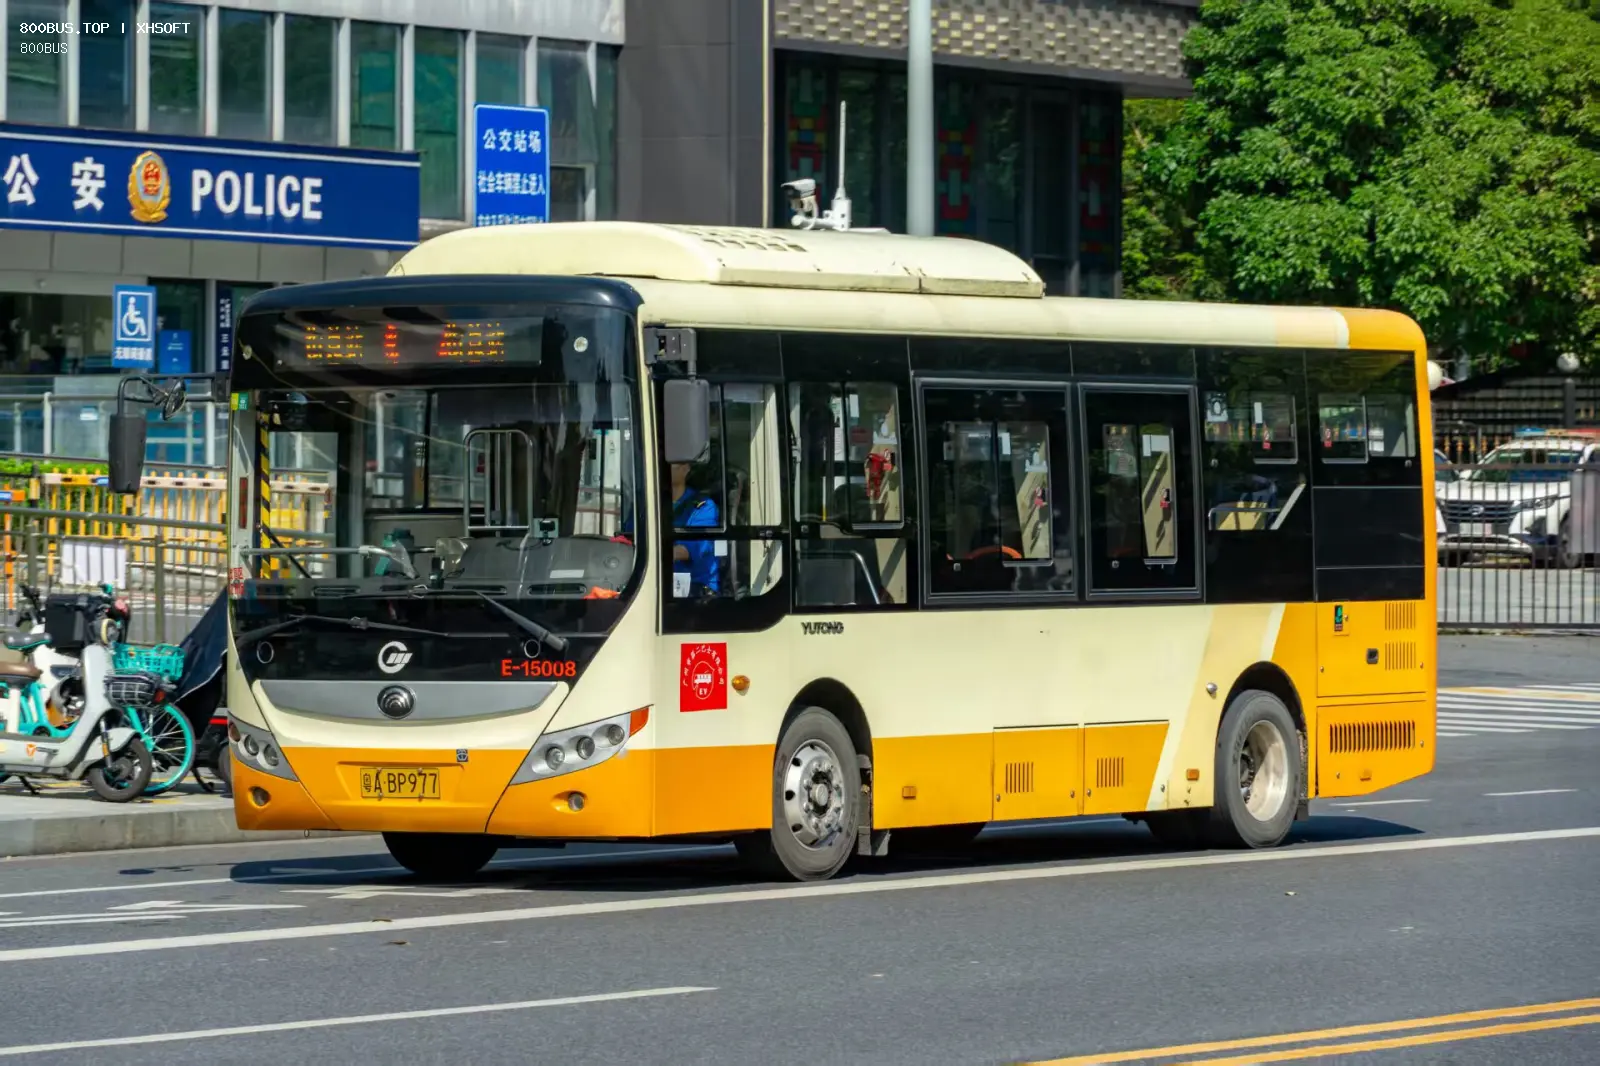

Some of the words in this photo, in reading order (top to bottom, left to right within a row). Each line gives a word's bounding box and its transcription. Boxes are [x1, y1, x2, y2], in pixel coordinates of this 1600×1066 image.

[483, 128, 542, 154] 公交站场
[3, 153, 106, 212] 公安
[191, 169, 323, 220] POLICE
[801, 620, 844, 635] YUTONG
[501, 660, 576, 677] E-15008
